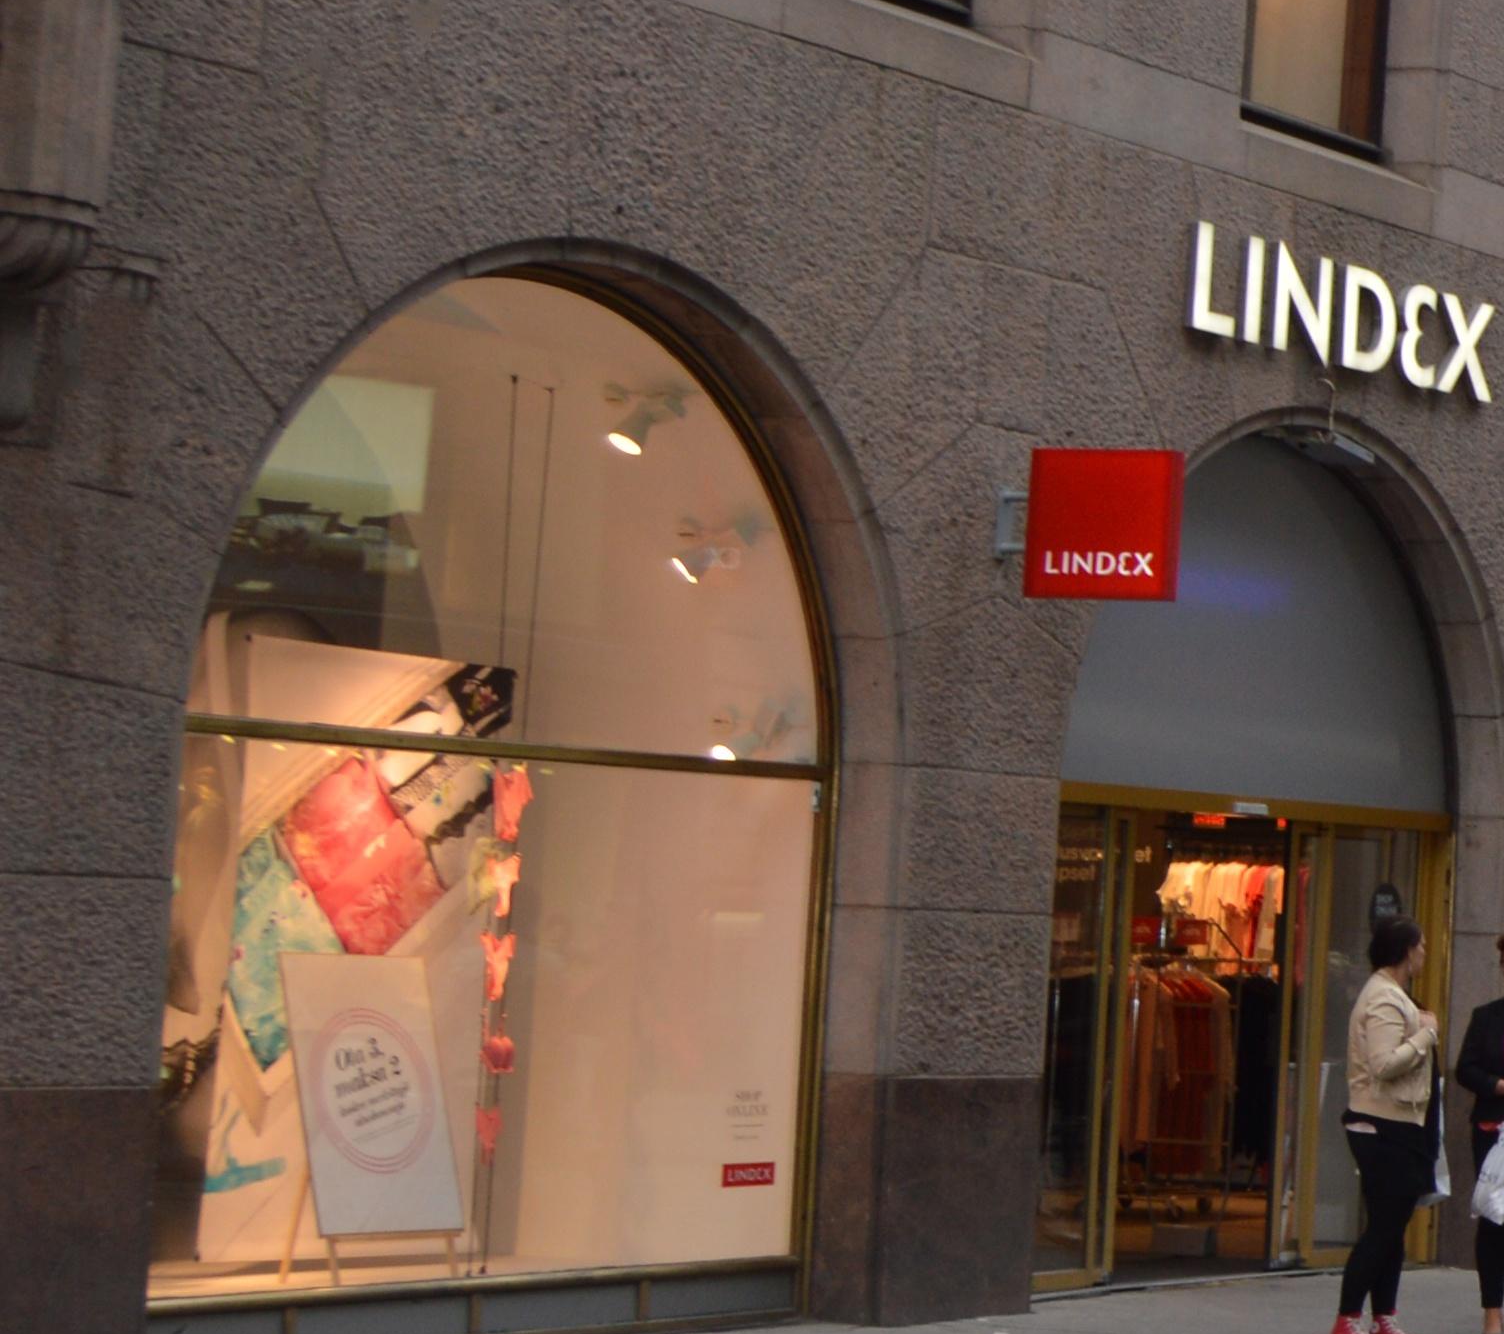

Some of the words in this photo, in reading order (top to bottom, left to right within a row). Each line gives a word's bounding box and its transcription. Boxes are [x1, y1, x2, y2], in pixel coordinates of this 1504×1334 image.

[1187, 220, 1495, 404] LINDEX
[1044, 551, 1154, 577] LINDEX
[727, 1167, 773, 1183] LINDEX
